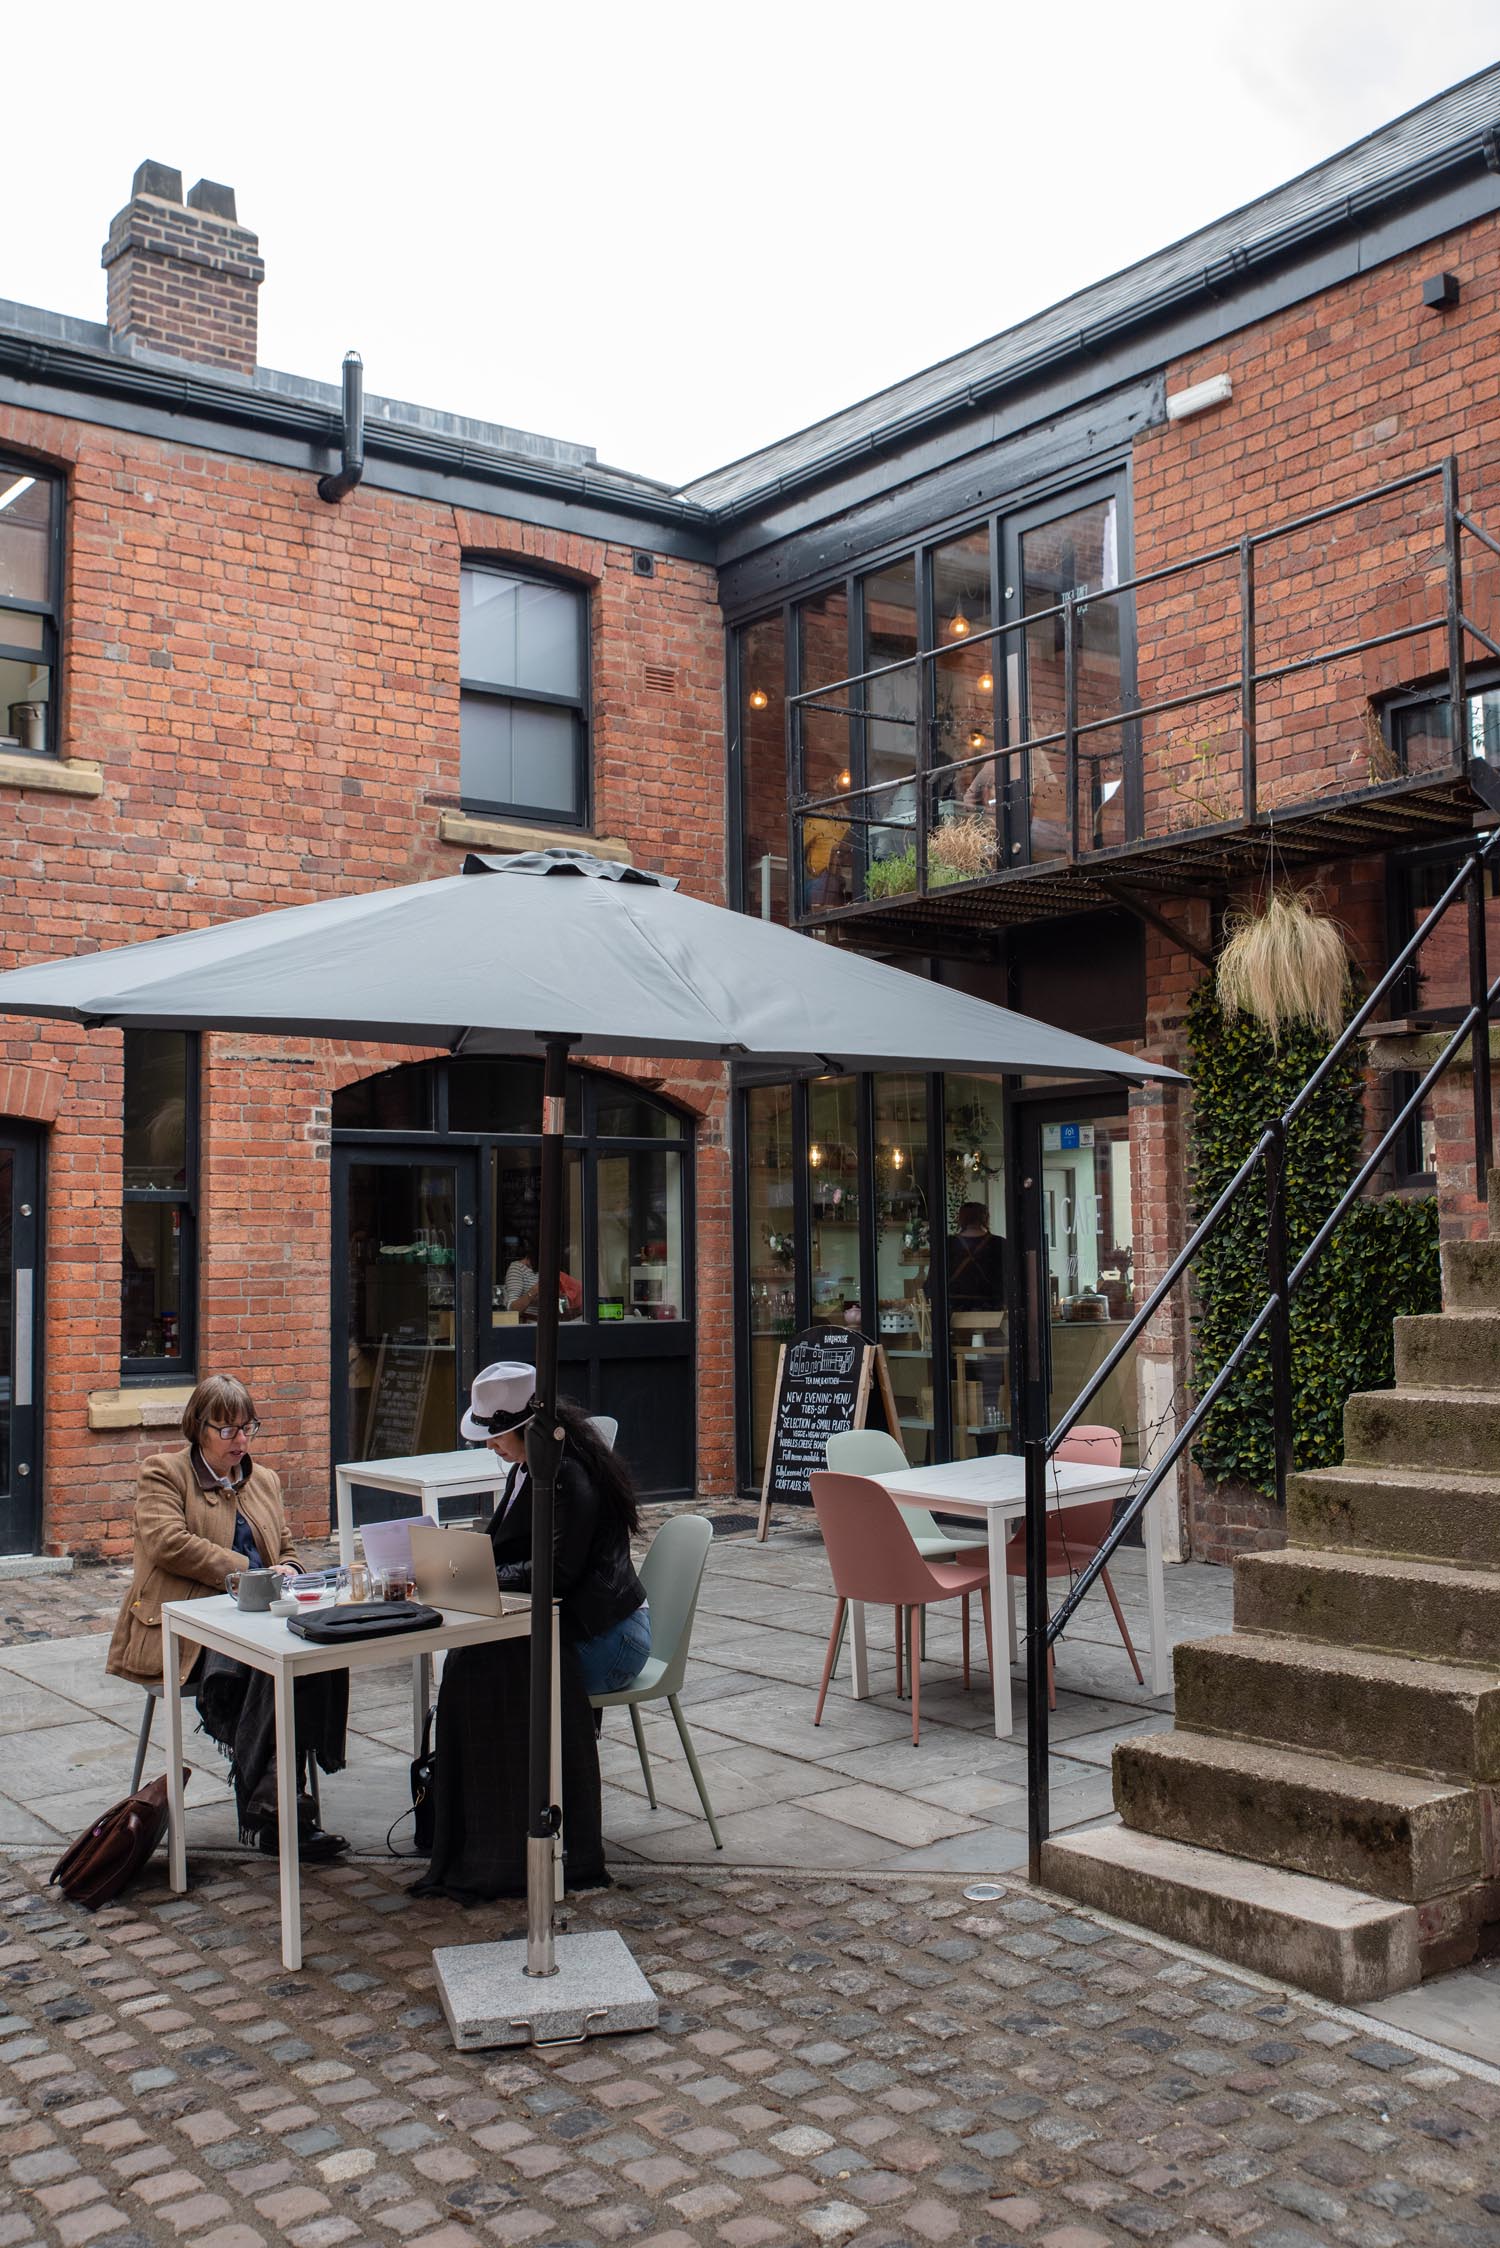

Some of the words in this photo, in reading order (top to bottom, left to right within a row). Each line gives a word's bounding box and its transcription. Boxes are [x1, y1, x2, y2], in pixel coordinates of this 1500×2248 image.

[786, 1391, 802, 1403] NEW
[804, 1392, 833, 1404] EVENING
[833, 1393, 851, 1405] MENU
[783, 1417, 811, 1429] SELECTION
[816, 1418, 831, 1431] SMALL
[831, 1420, 851, 1431] PLATES
[775, 1479, 791, 1490] CRAFT
